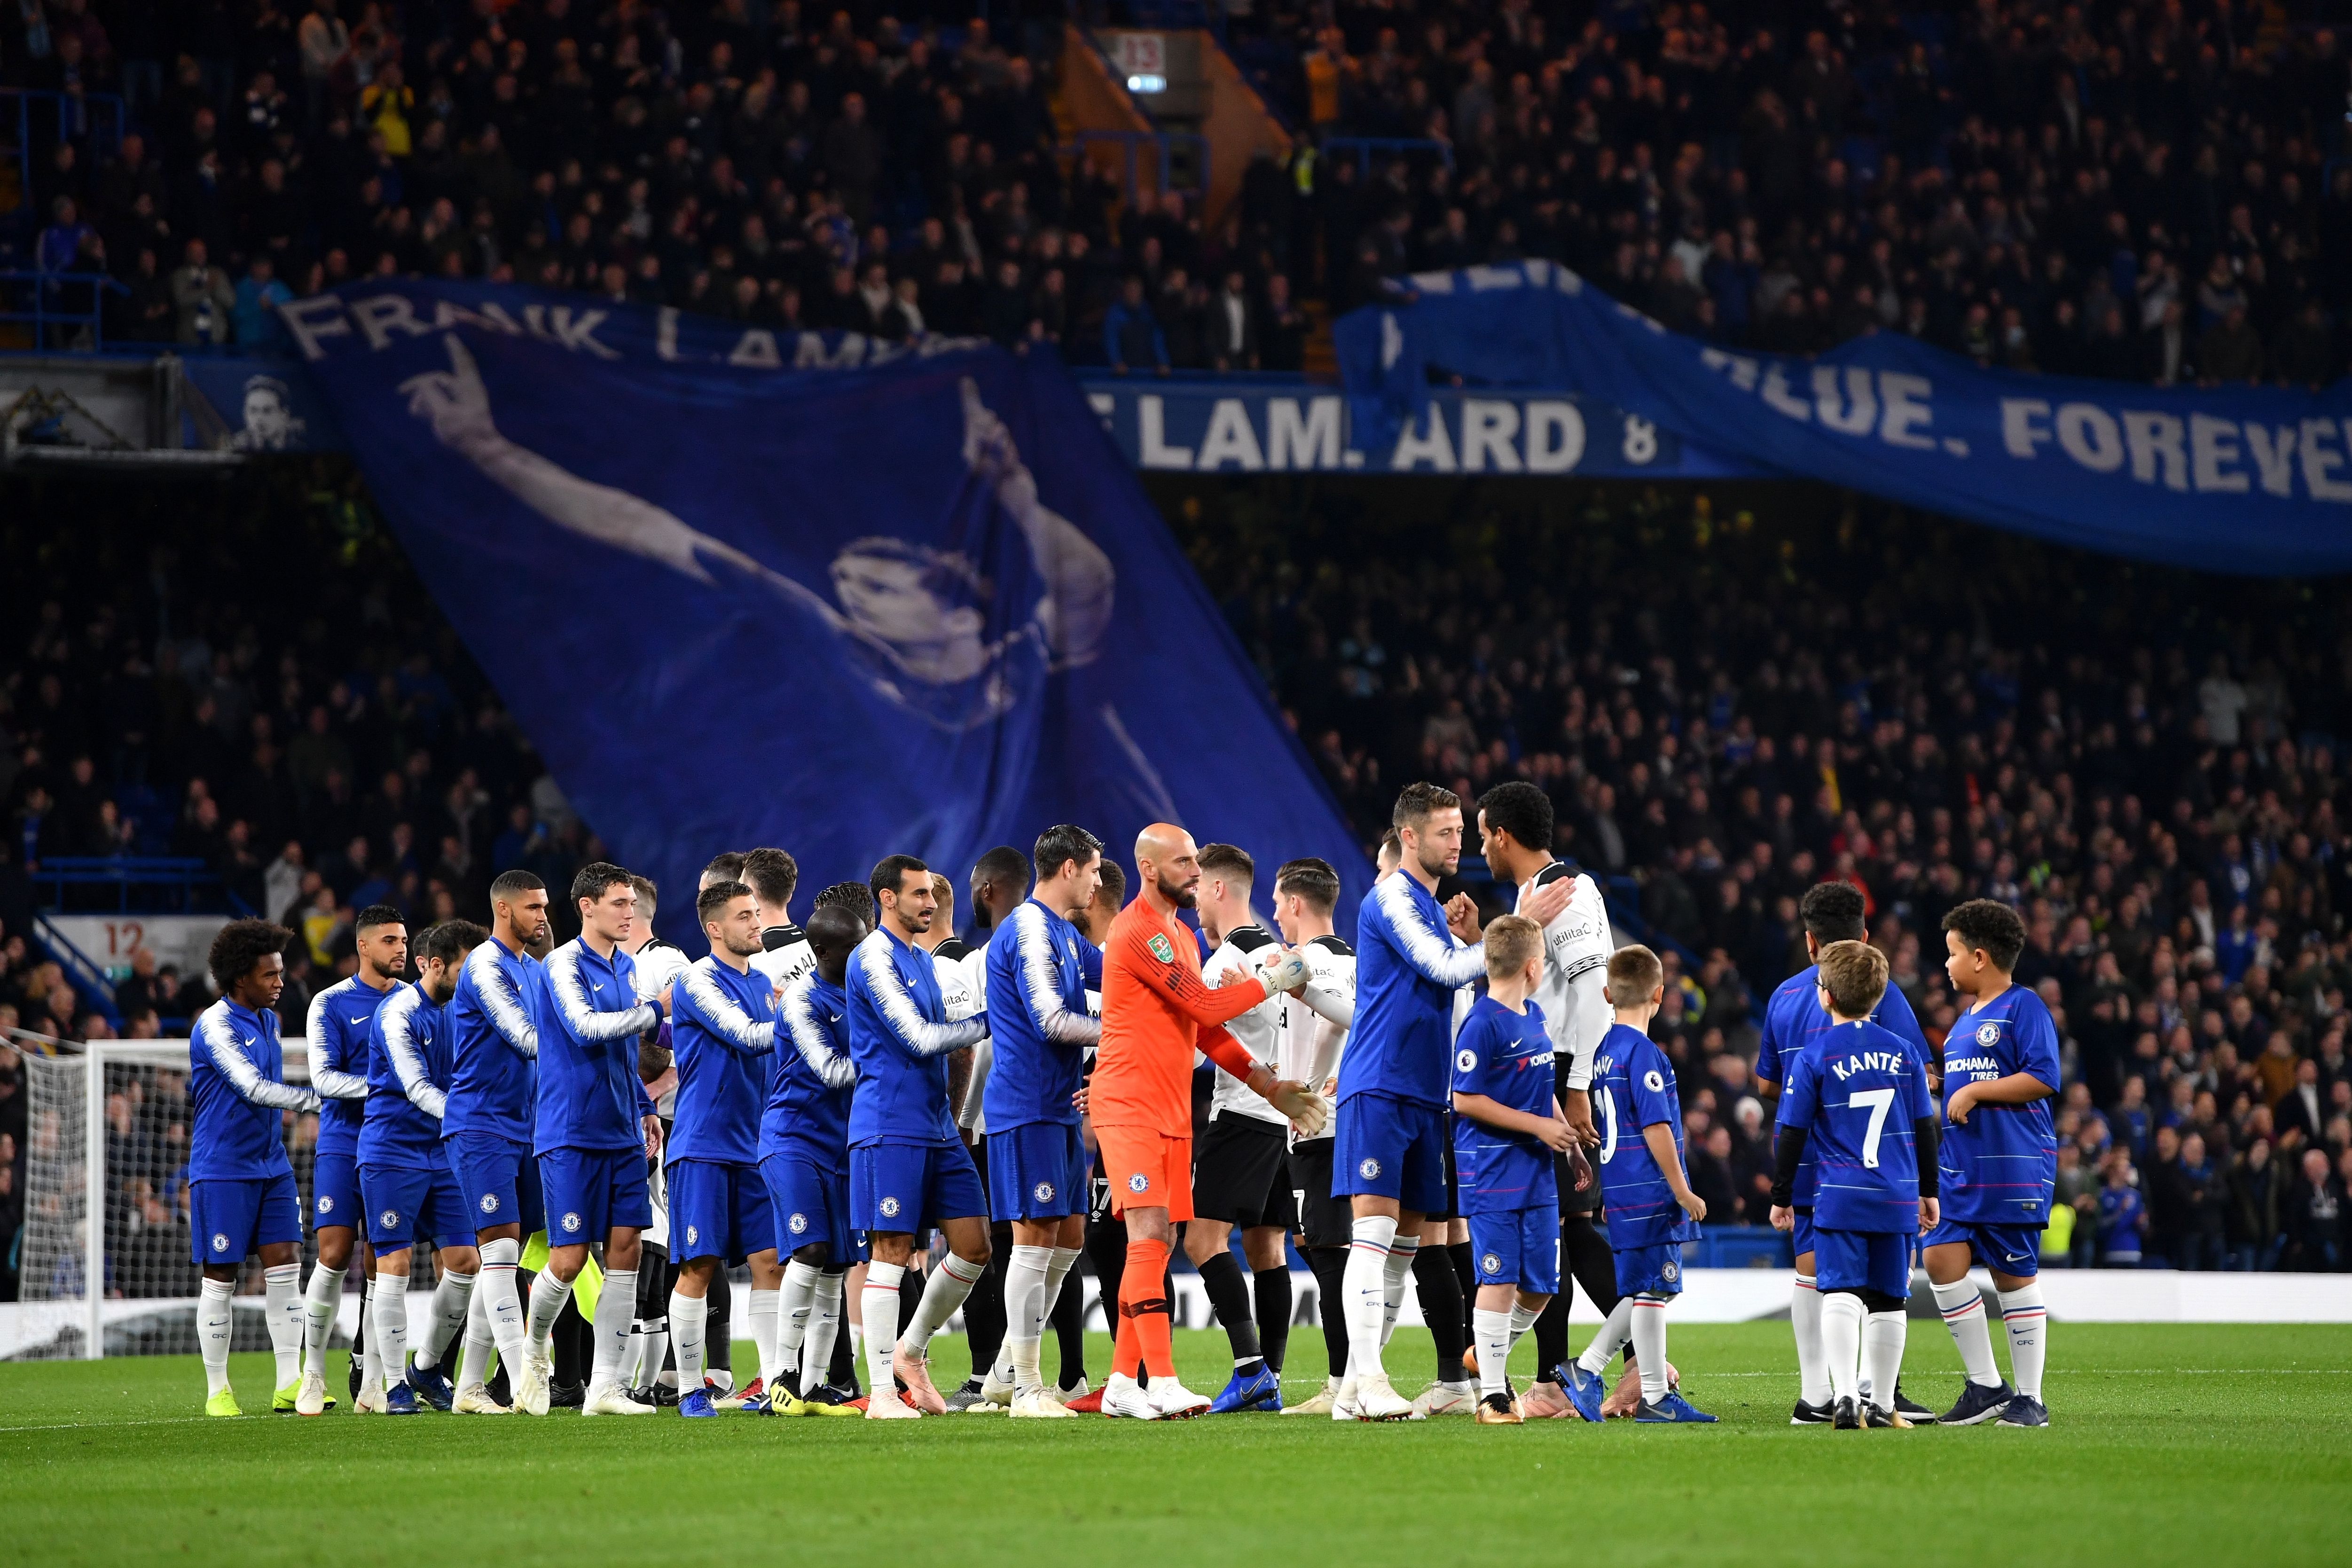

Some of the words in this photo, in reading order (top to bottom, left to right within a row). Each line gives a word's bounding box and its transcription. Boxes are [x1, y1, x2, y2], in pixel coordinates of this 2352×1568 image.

[1138, 394, 1586, 473] LAMARD
[2000, 397, 2352, 504] FOREVE
[105, 922, 143, 957] 12
[1553, 928, 1584, 946] utilita
[1262, 970, 1278, 990] WILLY
[1832, 1052, 1902, 1081] KANTÉ
[1970, 1071, 1999, 1081] TYRES
[1849, 1088, 1895, 1169] 7
